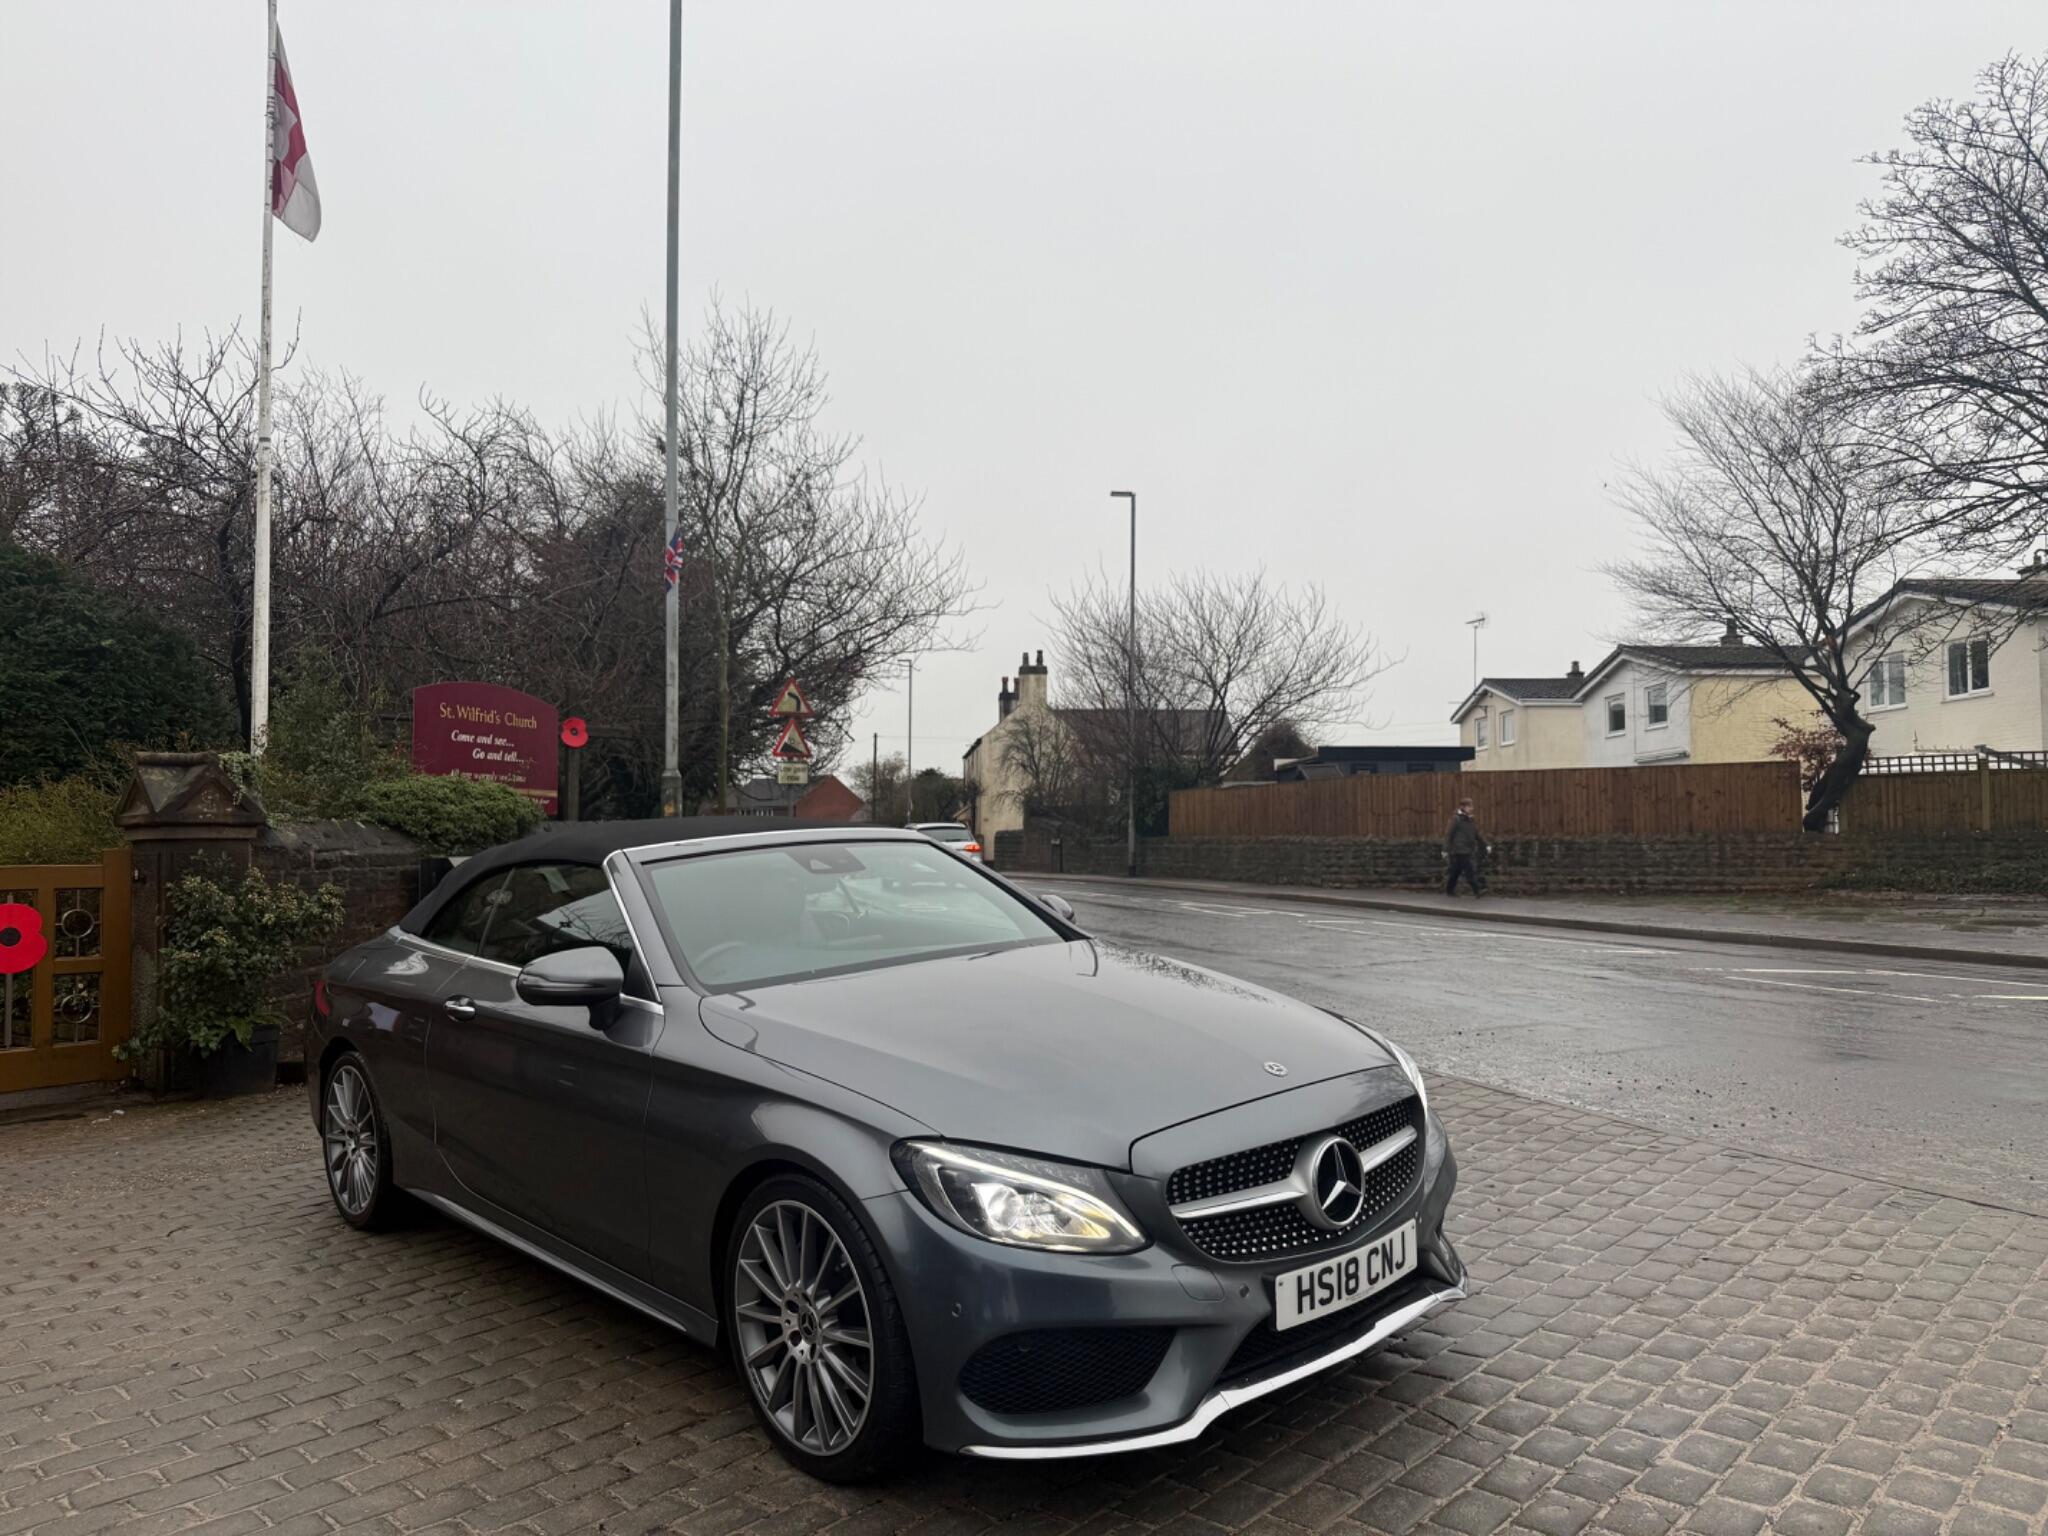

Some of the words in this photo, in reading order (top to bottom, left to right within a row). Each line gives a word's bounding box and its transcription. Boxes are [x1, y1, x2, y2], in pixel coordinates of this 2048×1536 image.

[440, 702, 455, 719] St.
[457, 704, 501, 725] Wilfrid's
[504, 712, 538, 729] Church
[451, 729, 475, 743] Come
[477, 734, 493, 745] and
[472, 748, 486, 760] Go
[487, 750, 503, 761] and
[1297, 1256, 1359, 1315] HS18
[1367, 1231, 1406, 1286] CNJ
